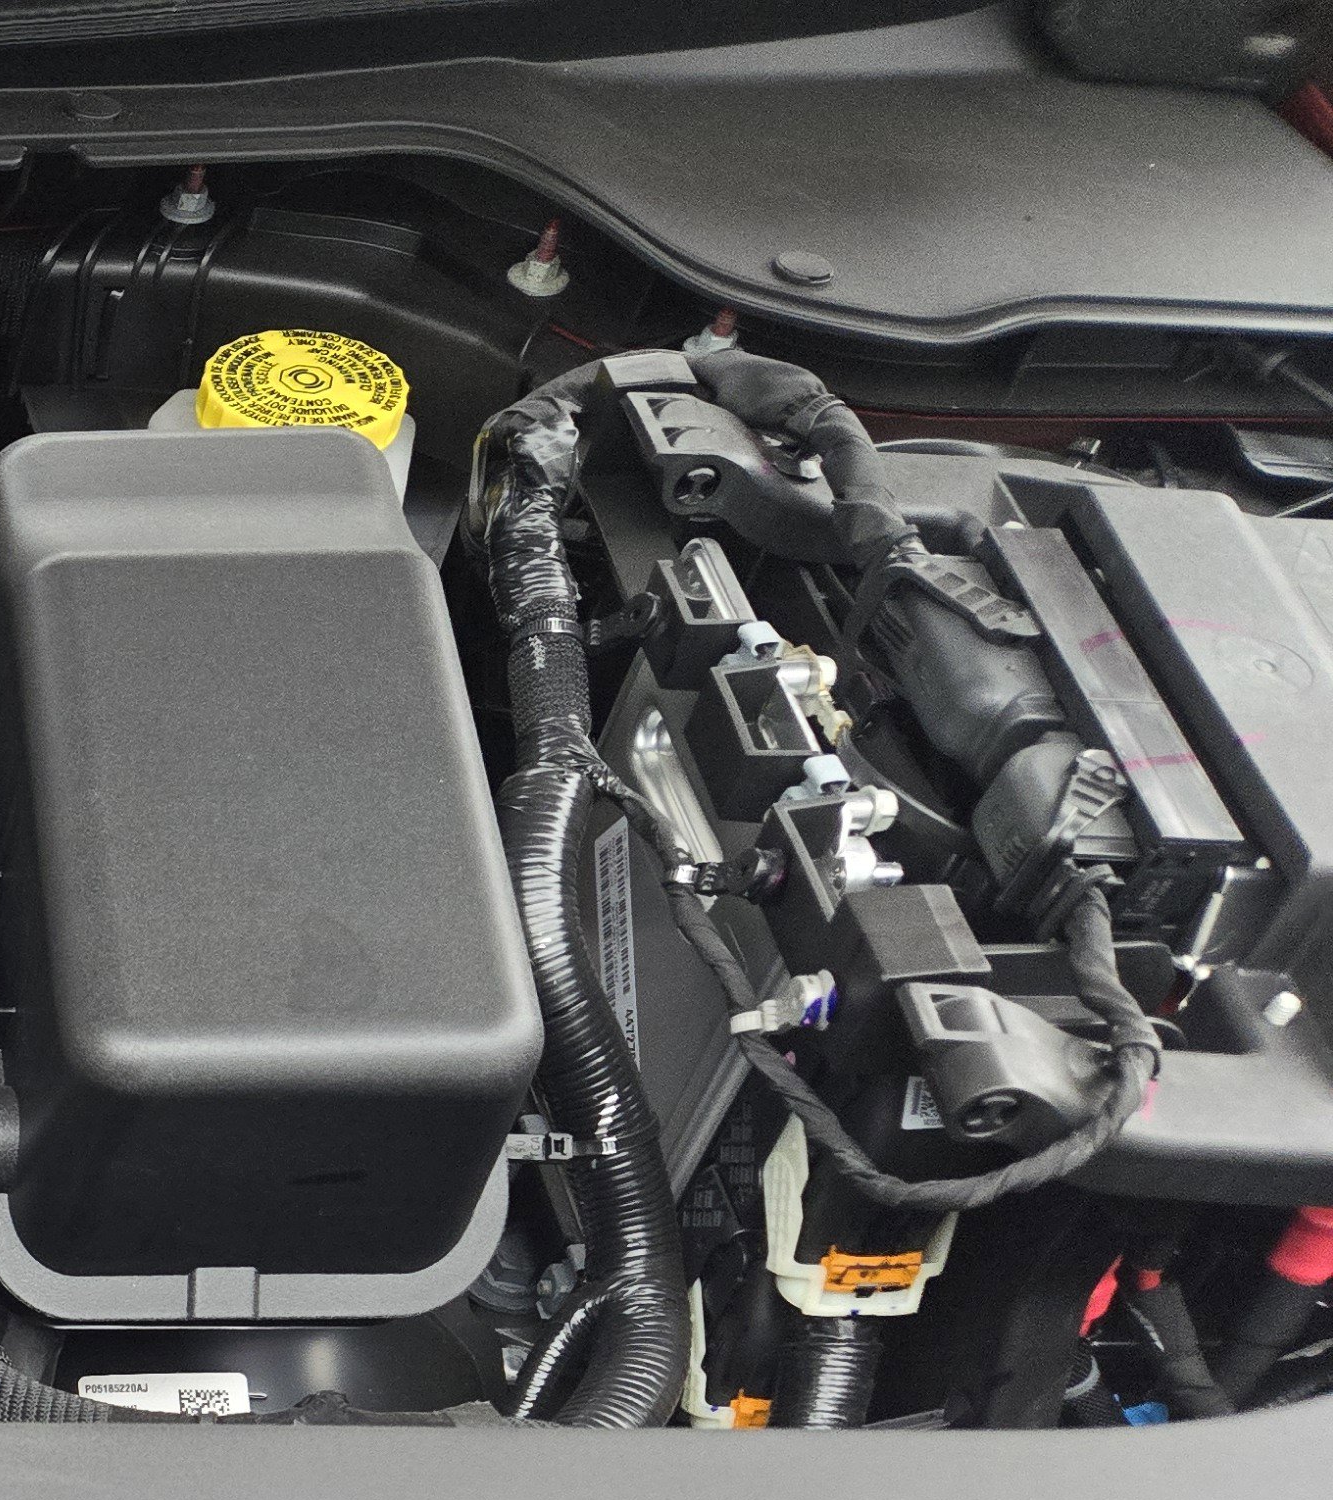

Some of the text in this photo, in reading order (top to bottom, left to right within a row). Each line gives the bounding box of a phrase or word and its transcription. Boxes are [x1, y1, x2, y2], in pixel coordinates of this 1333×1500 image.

[213, 335, 264, 366] REMPLISSAGE
[321, 341, 342, 351] USE
[343, 340, 377, 357] SEALED
[225, 344, 265, 375] UNIQUEMENT
[307, 348, 372, 391] CLEAN FILLER CAP
[378, 361, 399, 377] FROM
[211, 374, 235, 402] BOUCHON
[369, 381, 387, 404] BEFORE
[262, 386, 333, 407] CONTENANT
[229, 401, 244, 410] LE
[264, 400, 287, 411] DOT
[333, 403, 350, 413] DU
[381, 399, 399, 411] DOT
[290, 407, 333, 416] LIQUIDE
[327, 411, 360, 421] AVANT
[294, 415, 307, 424] LE
[309, 416, 325, 424] DE
[85, 1383, 148, 1394] P05185220AJ
